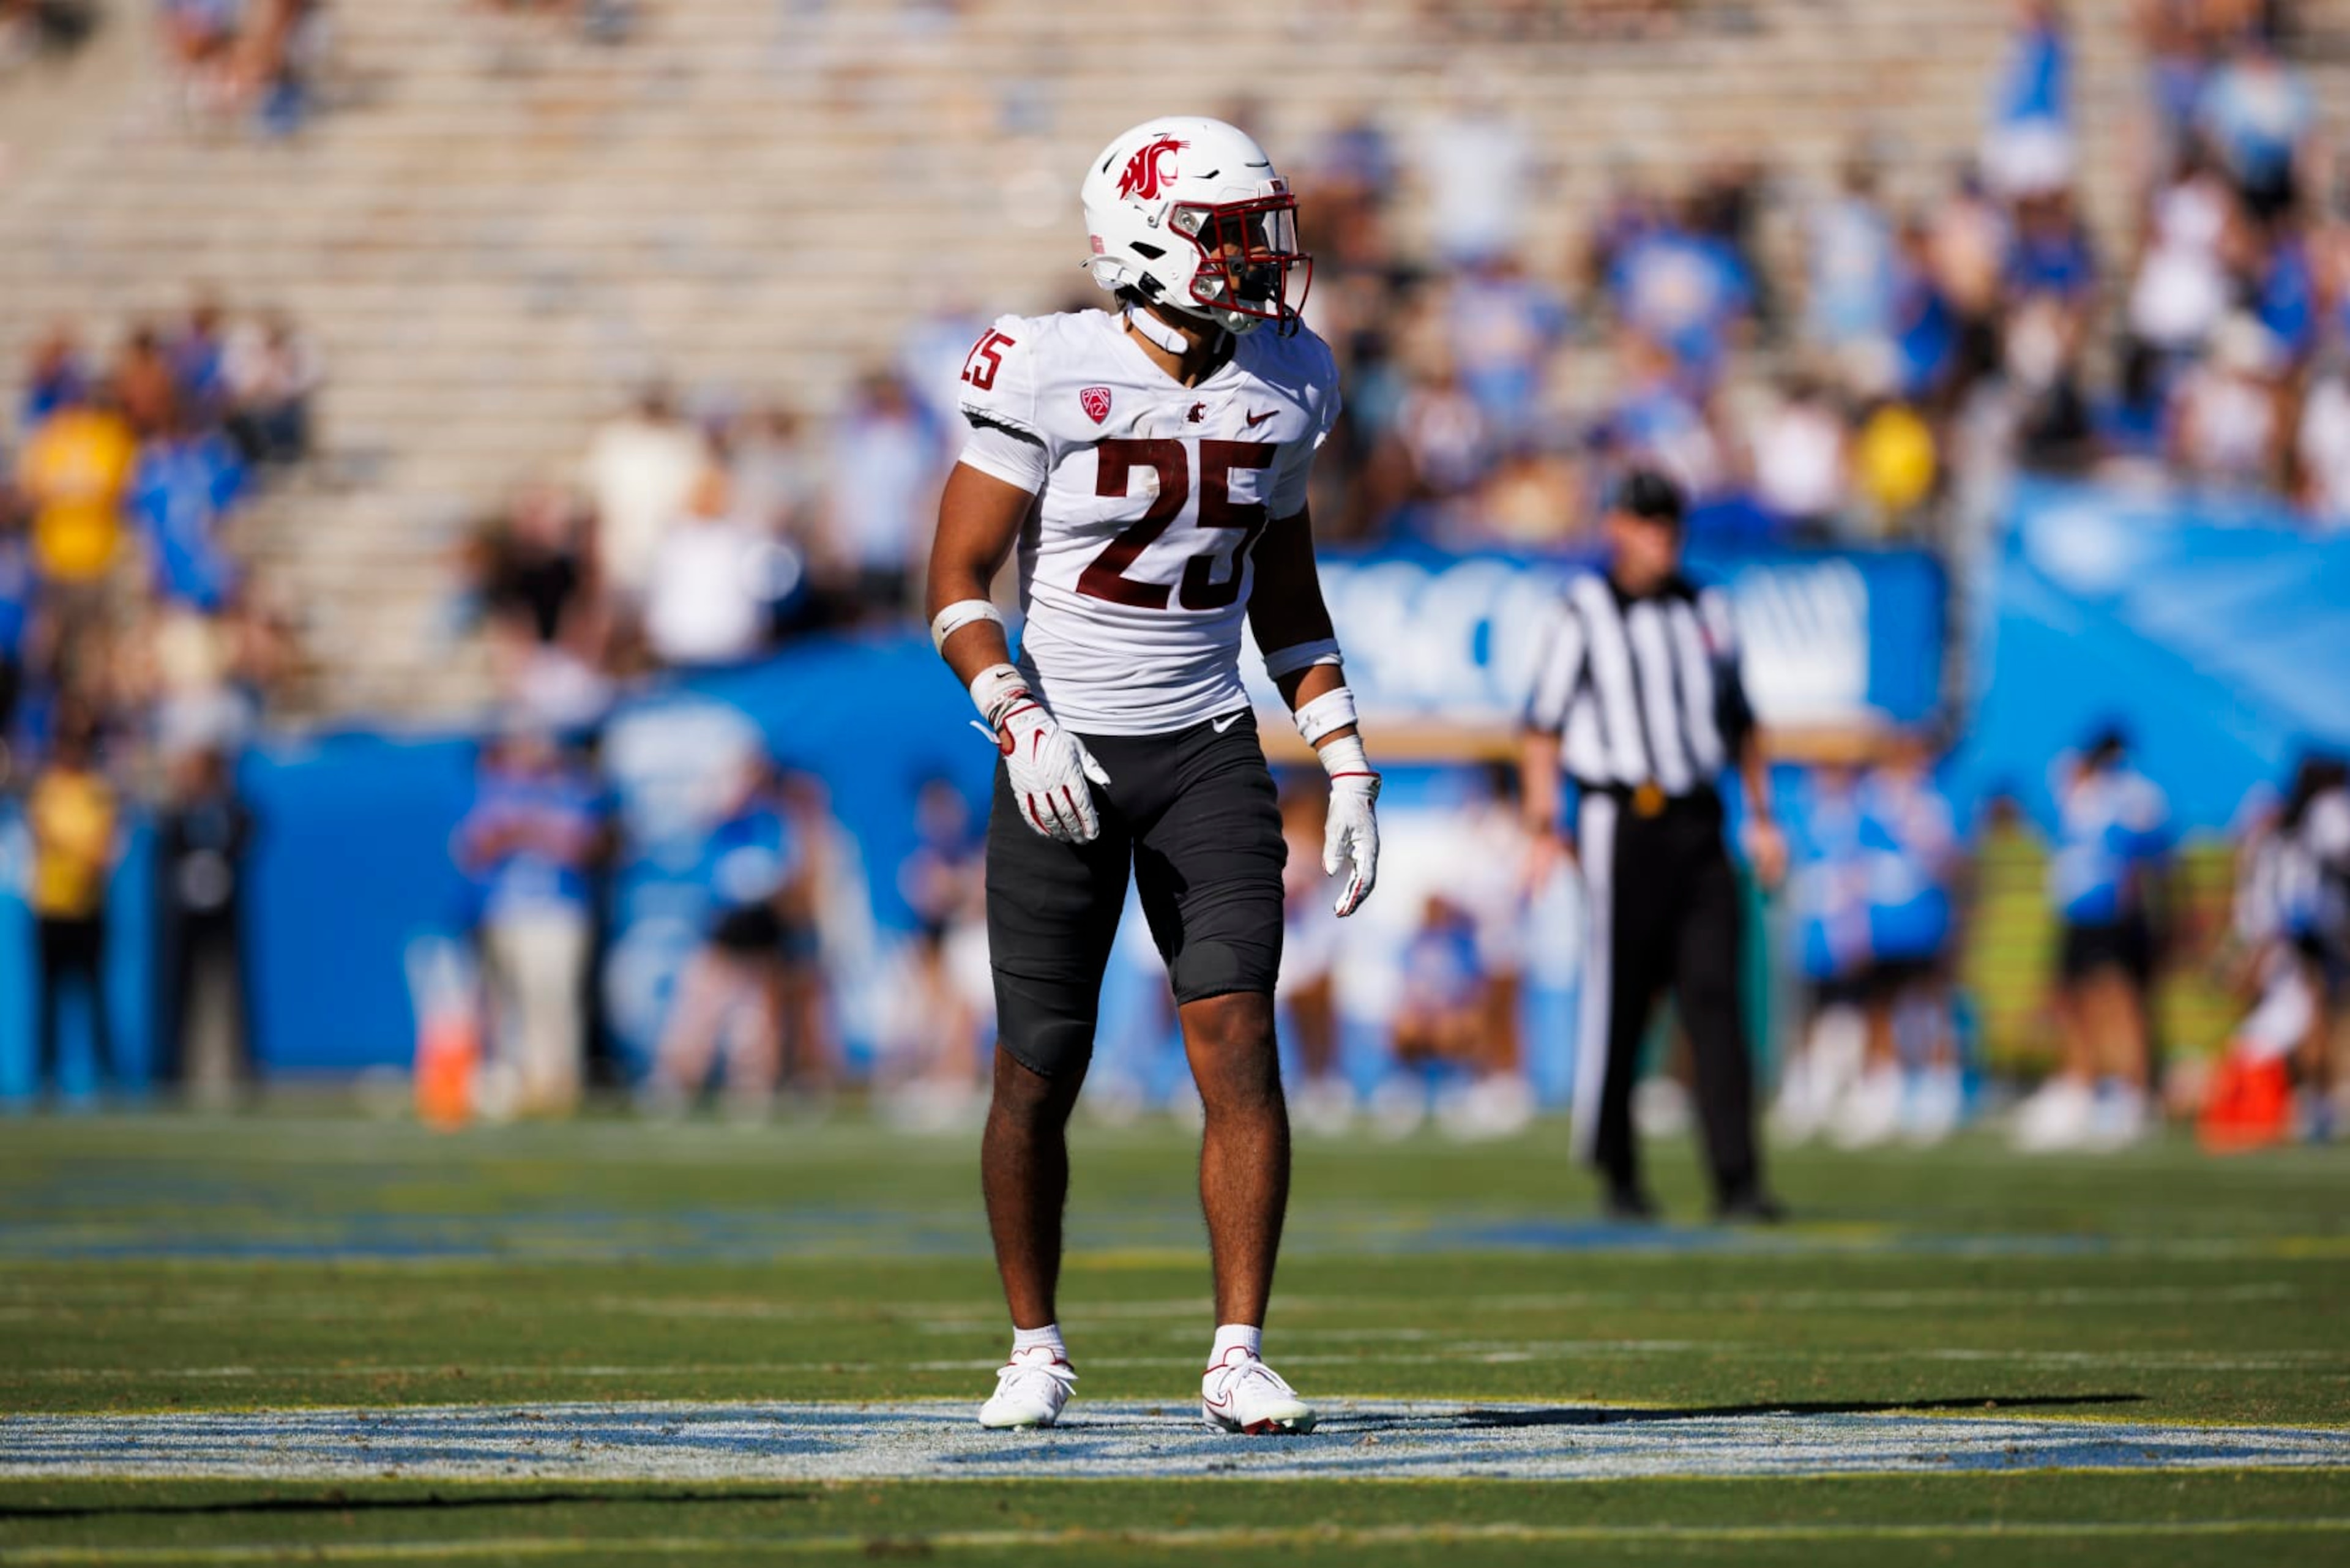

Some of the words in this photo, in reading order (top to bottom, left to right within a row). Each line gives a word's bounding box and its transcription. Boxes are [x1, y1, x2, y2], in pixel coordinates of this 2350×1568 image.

[1081, 389, 1109, 409] PAC
[1089, 401, 1106, 416] 12
[1076, 438, 1278, 610] 25
